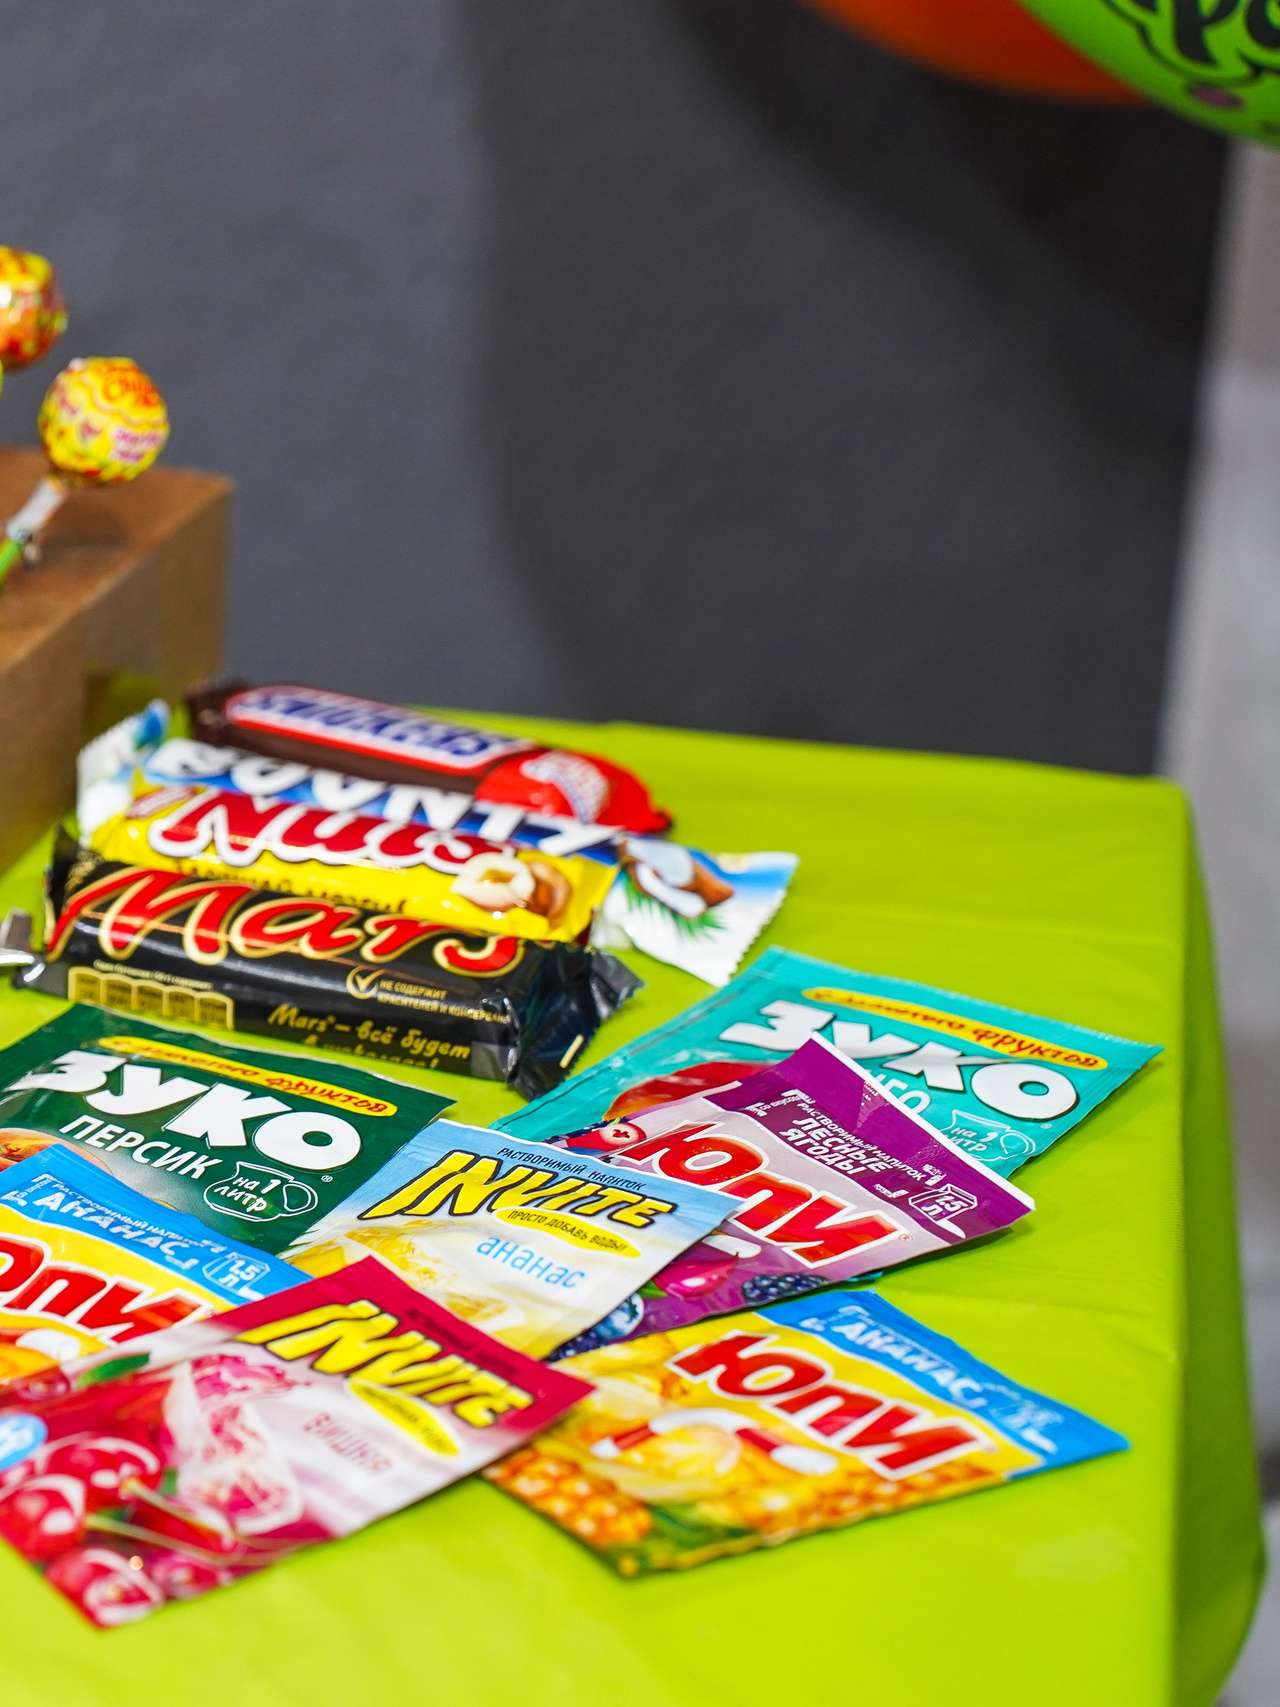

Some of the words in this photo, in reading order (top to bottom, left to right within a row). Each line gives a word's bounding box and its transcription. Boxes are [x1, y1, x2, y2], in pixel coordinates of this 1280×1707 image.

[147, 785, 515, 875] Nuts
[45, 865, 523, 977] Mars
[400, 1029, 471, 1060] будет
[720, 998, 1080, 1120] ЗУКО
[5, 1050, 362, 1171] ЗУКО
[59, 1115, 223, 1182] ПЕРСИК
[496, 1146, 587, 1175] РАСТВОРИМЫЙ
[587, 1170, 646, 1192] НАПИТОК
[779, 1127, 870, 1176] ЯГОДЫ
[792, 1117, 894, 1173] ЛЕСНЫЕ
[872, 1145, 927, 1181] НАПИТОК
[232, 1176, 255, 1191] на
[261, 1179, 281, 1195] 1
[357, 1149, 678, 1230] INVITE
[936, 1194, 969, 1212] 1.5
[33, 1192, 191, 1257] АНАНАС
[507, 1210, 547, 1225] ПРОСТО
[546, 1218, 589, 1241] ДОБАВЬ
[475, 1233, 587, 1292] ананас
[233, 1298, 535, 1431] INVITE
[830, 1321, 985, 1402] АНАНАС
